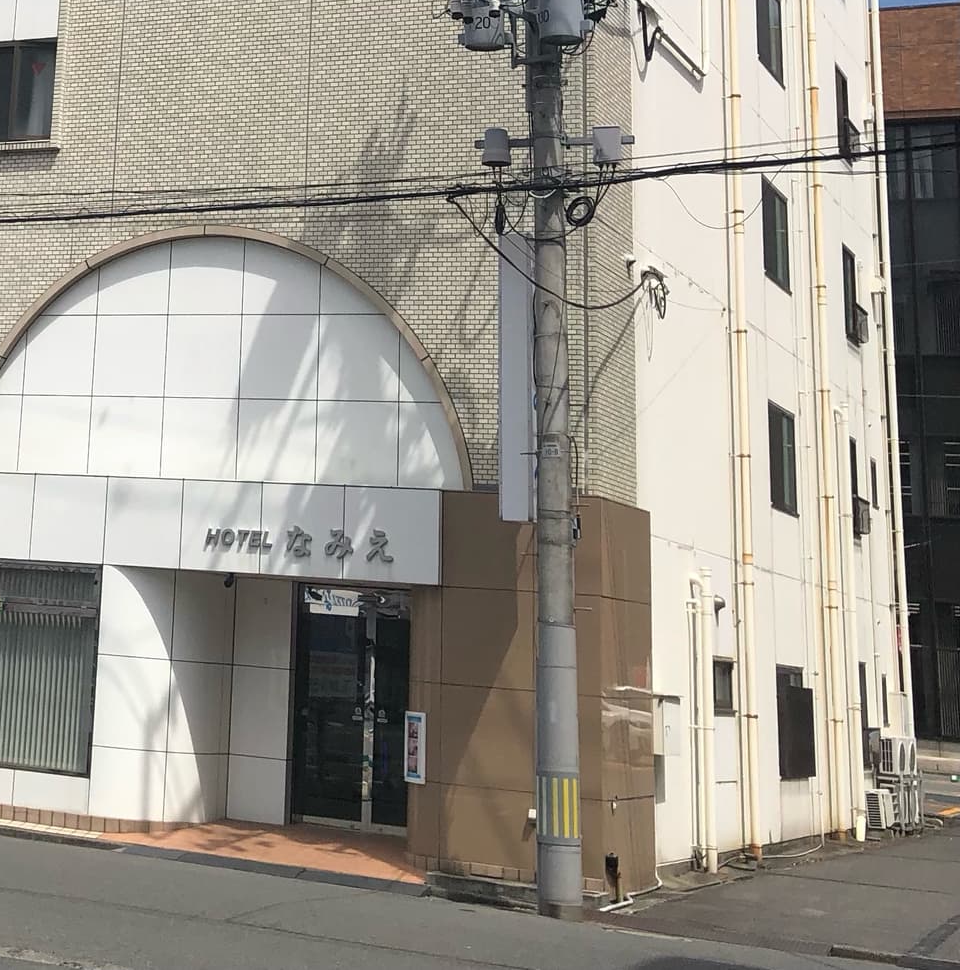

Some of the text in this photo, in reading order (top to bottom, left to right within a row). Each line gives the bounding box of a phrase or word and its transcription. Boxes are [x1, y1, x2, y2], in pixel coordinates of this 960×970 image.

[475, 16, 490, 29] 20
[205, 525, 394, 563] HOTEL なみえ
